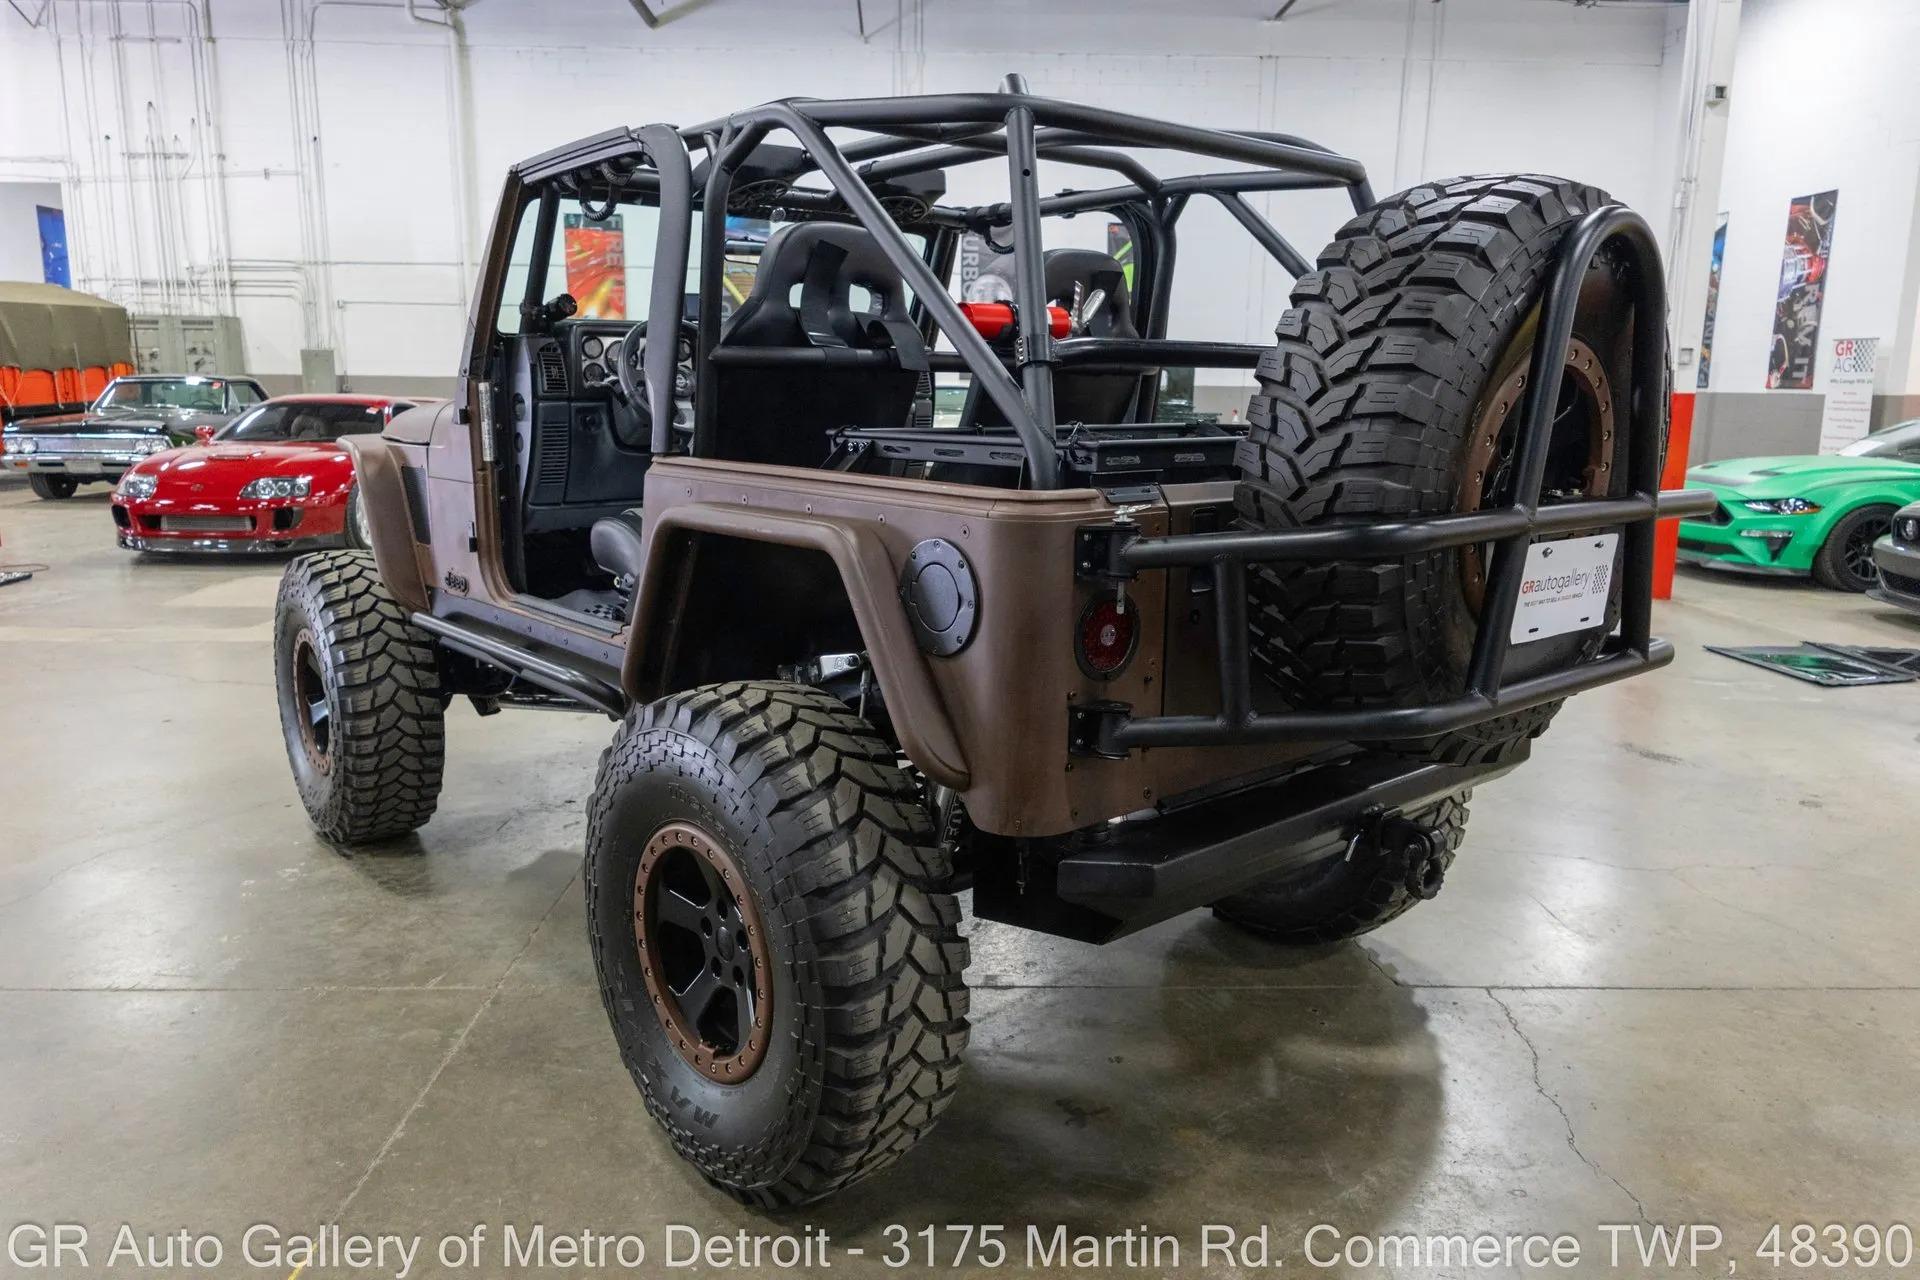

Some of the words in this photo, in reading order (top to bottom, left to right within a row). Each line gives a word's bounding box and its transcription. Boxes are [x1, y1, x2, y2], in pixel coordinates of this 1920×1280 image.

[963, 234, 979, 296] URBO
[1835, 340, 1854, 357] GR
[1833, 357, 1851, 373] AG
[445, 571, 470, 596] Jeep
